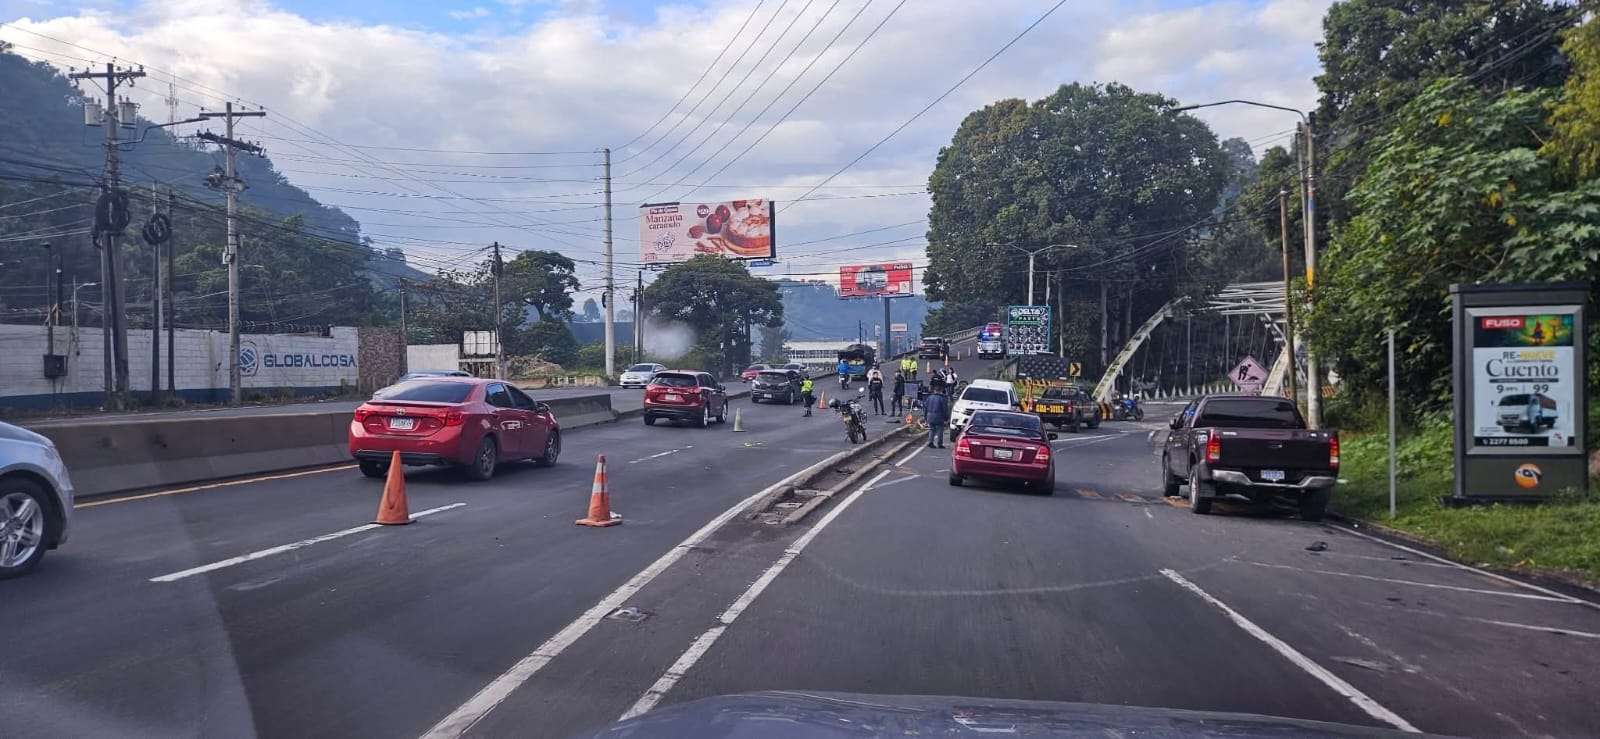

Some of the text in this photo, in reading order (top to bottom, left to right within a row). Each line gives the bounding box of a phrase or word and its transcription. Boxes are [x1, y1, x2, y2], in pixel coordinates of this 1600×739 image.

[646, 214, 683, 223] Manzana
[649, 221, 681, 230] caramelo
[1485, 318, 1521, 327] FUSO
[1486, 358, 1558, 377] Cuento
